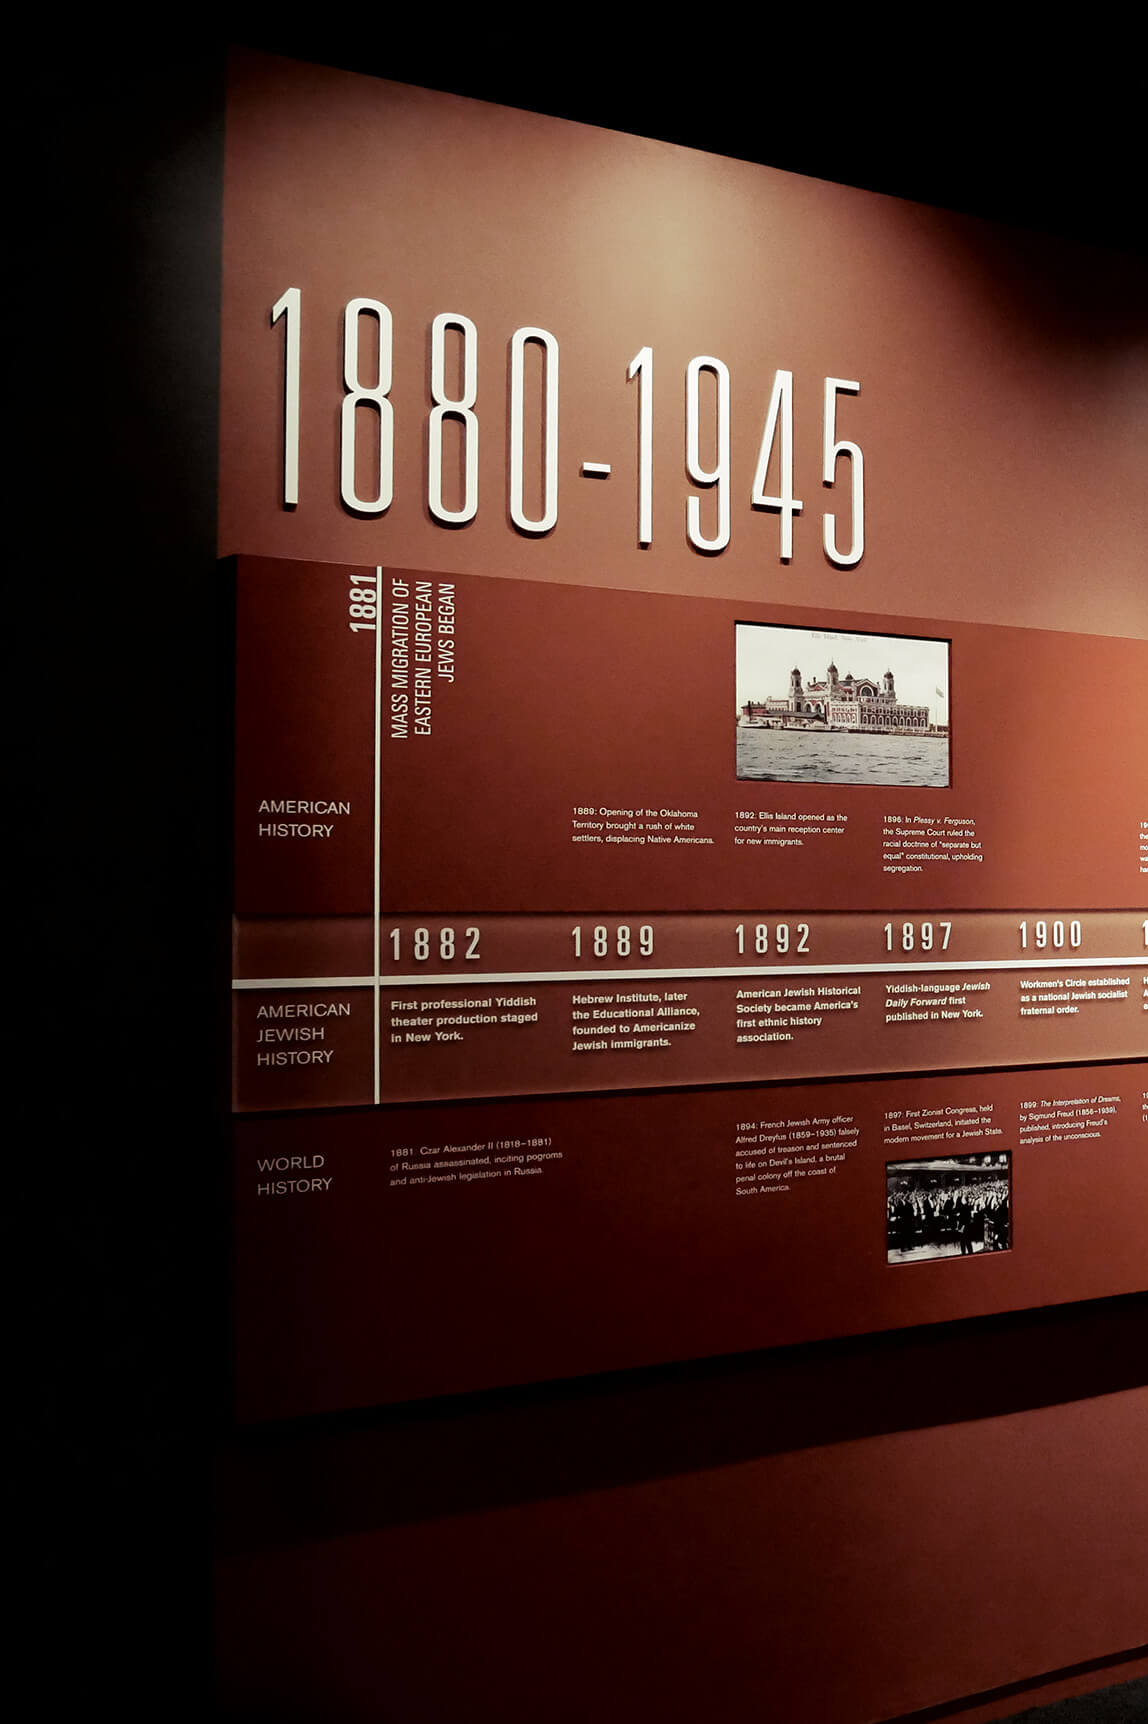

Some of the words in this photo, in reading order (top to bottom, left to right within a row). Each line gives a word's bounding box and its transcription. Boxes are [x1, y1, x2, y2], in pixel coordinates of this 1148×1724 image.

[272, 287, 864, 565] 1880-1945
[392, 577, 409, 597] OF
[350, 574, 377, 632] 1881
[438, 583, 455, 634] BEGAN
[414, 580, 433, 662] EUROPEAN
[392, 603, 409, 688] MIGRATION
[438, 638, 454, 682] JEWS
[414, 666, 432, 736] EASTERN
[392, 694, 408, 738] MASS
[258, 800, 350, 816] AMERICAN
[573, 807, 597, 815] 1889:
[599, 807, 633, 818] Opening
[635, 808, 643, 816] of
[645, 808, 658, 816] the
[659, 808, 698, 818] Oklahoma
[758, 811, 773, 819] Ellis
[775, 812, 796, 820] Island
[797, 813, 824, 822] opened
[836, 813, 848, 821] the
[258, 823, 334, 838] HISTORY
[571, 819, 604, 831] Territory
[605, 820, 636, 831] brought
[645, 822, 662, 830] rush
[664, 822, 672, 830] of
[673, 822, 694, 830] white
[734, 824, 767, 834] country's
[787, 826, 820, 834] reception
[571, 834, 603, 843] settlers,
[605, 834, 645, 844] displacing
[647, 834, 671, 843] Native
[734, 836, 744, 844] for
[763, 838, 803, 847] immigrants.
[572, 925, 654, 957] 1889
[735, 924, 810, 954] 1892
[884, 922, 952, 950] 1897
[1020, 920, 1082, 948] 1900
[390, 928, 480, 961] 1882
[885, 983, 960, 993] Yiddish-language
[961, 981, 990, 991] Jewish
[1019, 979, 1063, 988] Workmen's
[1064, 978, 1086, 987] Circle
[1087, 976, 1130, 986] established
[572, 994, 613, 1004] Hebrew
[616, 992, 661, 1002] Institute,
[664, 992, 688, 1000] later
[735, 988, 781, 998] American
[783, 987, 815, 997] Jewish
[817, 985, 861, 995] Historical
[1038, 992, 1070, 1001] national
[1070, 991, 1096, 1000] Jewish
[1097, 990, 1128, 999] socialist
[390, 1000, 418, 1010] First
[420, 997, 492, 1011] professional
[495, 996, 536, 1006] Yiddish
[736, 1003, 772, 1014] Society
[774, 1003, 811, 1011] became
[813, 1000, 858, 1010] America's
[885, 998, 908, 1008] Daily
[909, 996, 947, 1006] Forward
[948, 996, 966, 1004] first
[1020, 1005, 1054, 1015] fraternal
[1056, 1004, 1079, 1014] order.
[256, 1003, 351, 1020] AMERICAN
[390, 1016, 433, 1026] theater
[436, 1014, 497, 1027] production
[500, 1011, 538, 1024] staged
[572, 1010, 590, 1019] the
[592, 1007, 654, 1018] Educational
[656, 1006, 700, 1016] Alliance,
[885, 1010, 928, 1022] published
[930, 1011, 939, 1019] in
[941, 1010, 960, 1018] New
[961, 1008, 983, 1018] York.
[572, 1024, 616, 1035] founded
[618, 1024, 630, 1032] to
[632, 1021, 696, 1032] Americanize
[736, 1018, 756, 1028] first
[758, 1017, 788, 1027] ethnic
[789, 1016, 822, 1026] history
[256, 1026, 324, 1044] JEWISH
[391, 1033, 402, 1042] in
[405, 1032, 431, 1042] New
[434, 1030, 463, 1040] York.
[736, 1032, 794, 1042] association.
[572, 1040, 607, 1050] Jewish
[610, 1037, 671, 1049] immigrants.
[256, 1050, 334, 1067] HISTORY
[736, 1122, 758, 1130] 1894:
[760, 1120, 785, 1128] French
[786, 1118, 810, 1127] Jewish
[811, 1117, 830, 1126] Army
[831, 1115, 853, 1123] officer
[735, 1135, 757, 1143] Alfred
[758, 1133, 786, 1143] Dreyfus
[838, 1126, 859, 1136] falsely
[256, 1154, 324, 1173] WORLD
[256, 1177, 333, 1196] HISTORY
